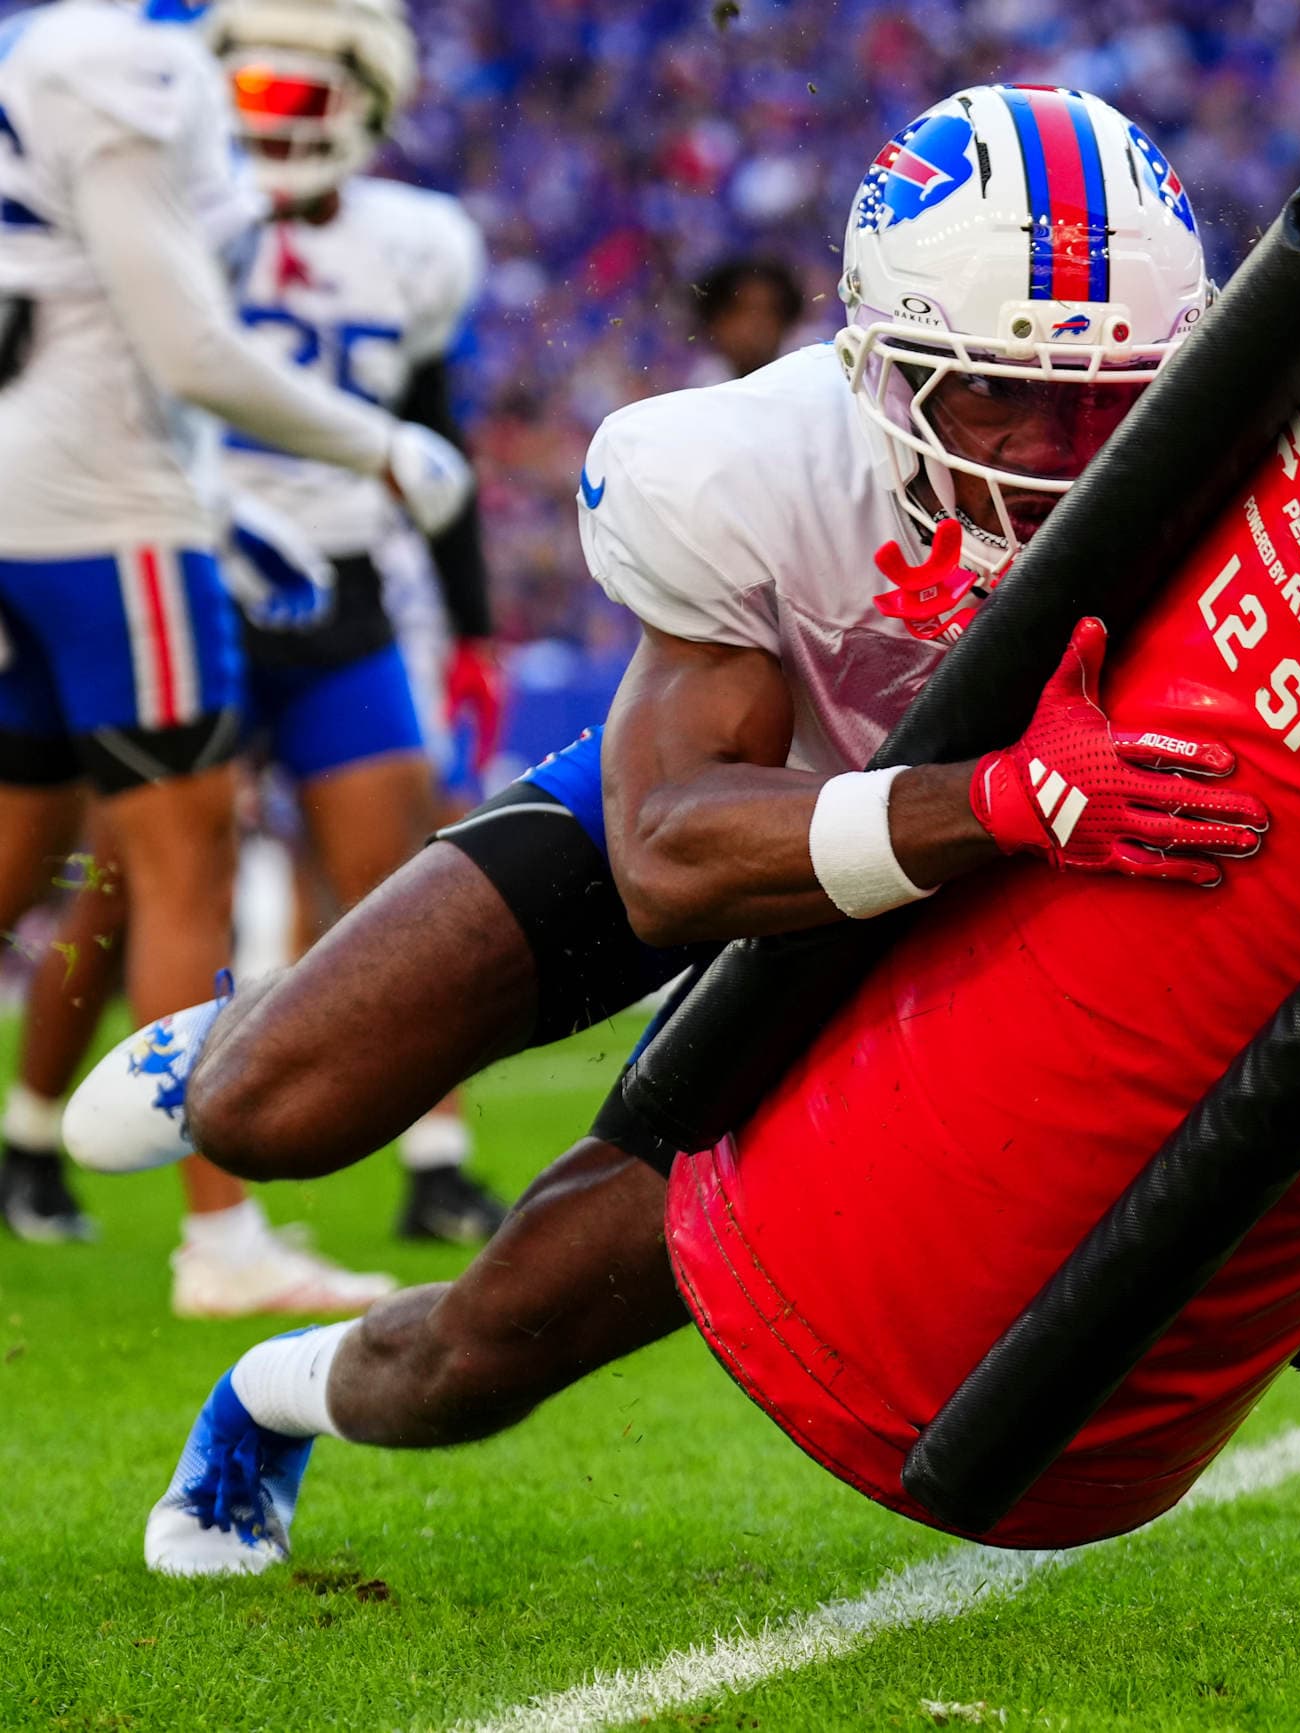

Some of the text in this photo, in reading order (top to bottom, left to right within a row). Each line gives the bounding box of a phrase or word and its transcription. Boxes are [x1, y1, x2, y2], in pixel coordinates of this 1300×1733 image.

[894, 310, 940, 326] OAKLEY
[1243, 495, 1277, 567] POWERED
[1268, 560, 1288, 586] BY
[1197, 553, 1268, 673] L2
[1136, 732, 1198, 757] ADIZERO
